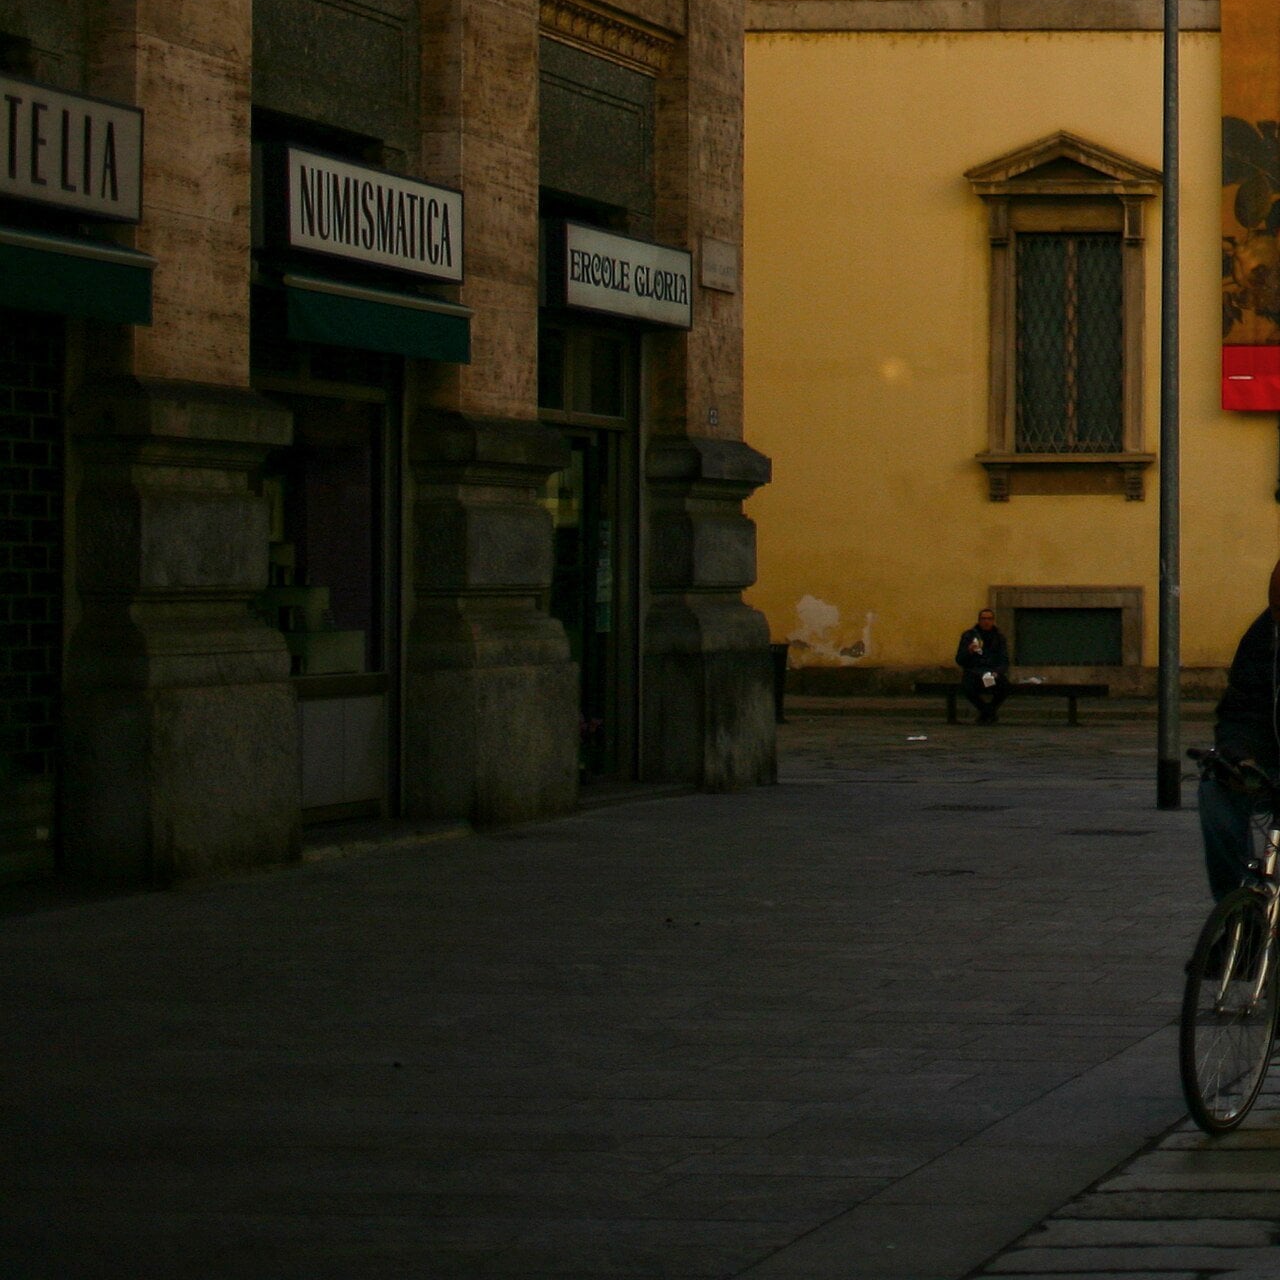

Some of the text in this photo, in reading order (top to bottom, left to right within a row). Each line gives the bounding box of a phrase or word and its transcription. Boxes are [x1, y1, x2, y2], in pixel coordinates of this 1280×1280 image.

[300, 165, 452, 268] NUMISMATICA
[569, 248, 631, 294] ERCOLE
[633, 264, 689, 306] GLORIA
